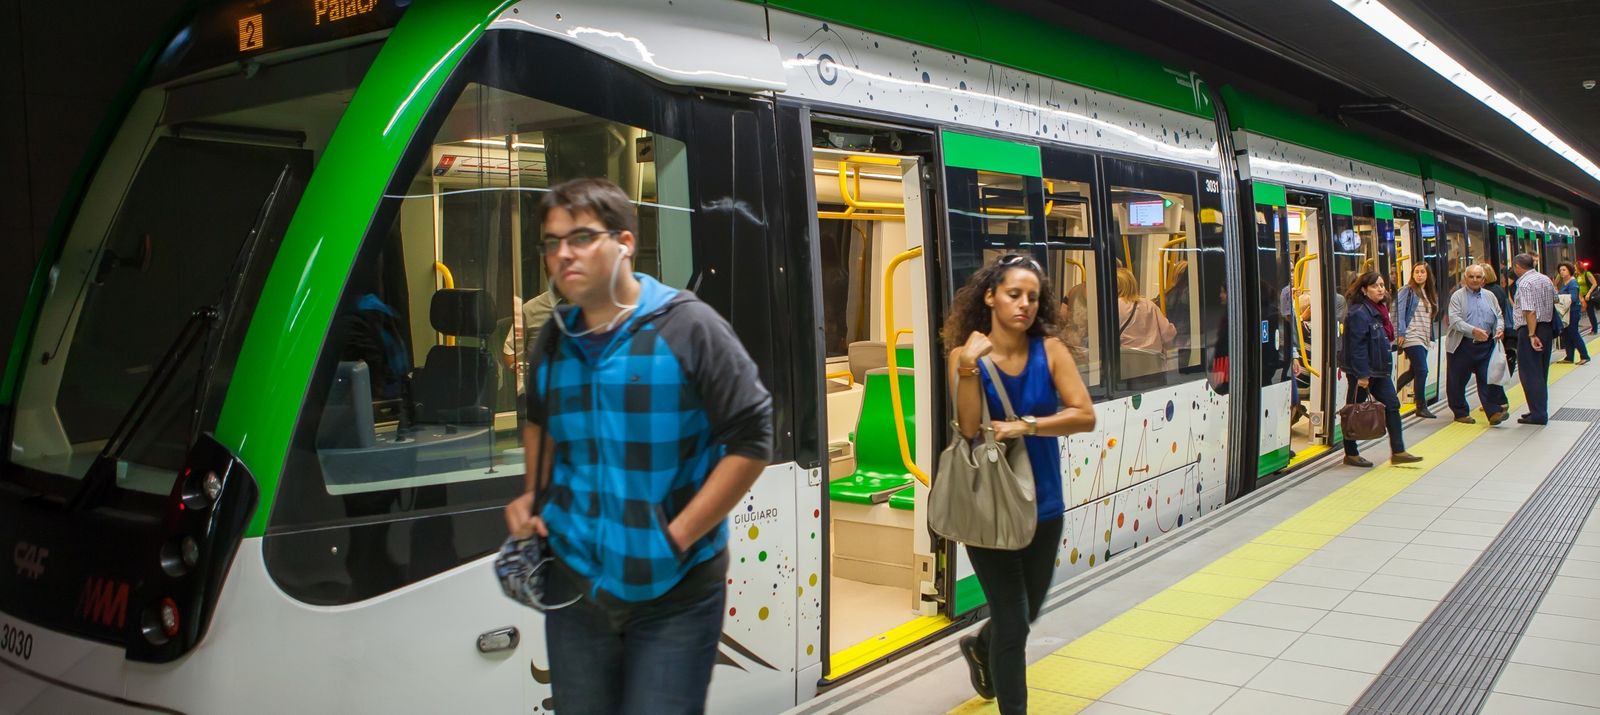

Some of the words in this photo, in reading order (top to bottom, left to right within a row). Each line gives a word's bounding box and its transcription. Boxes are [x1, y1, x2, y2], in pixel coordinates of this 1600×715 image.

[1205, 179, 1220, 194] 3031
[734, 508, 778, 524] GIUGIARO
[1, 624, 33, 660] 3030
